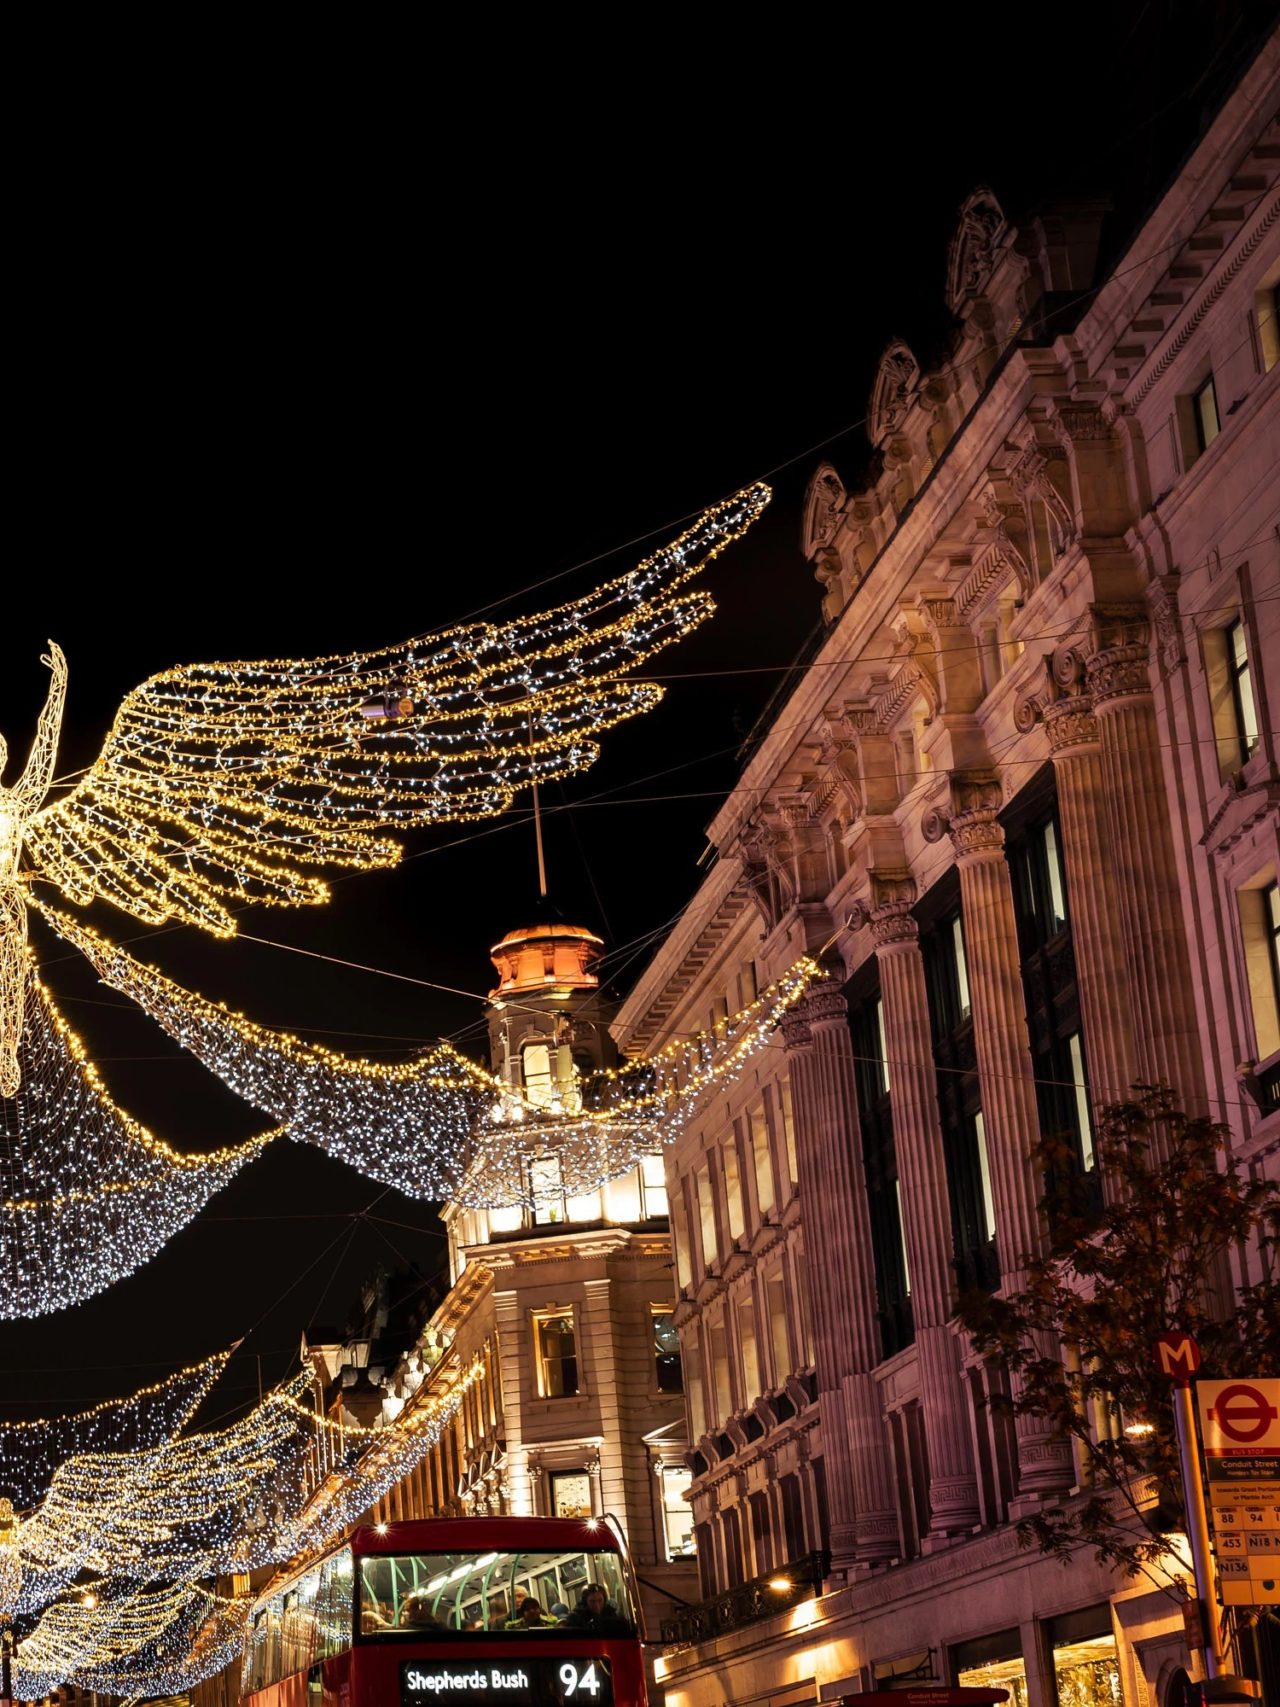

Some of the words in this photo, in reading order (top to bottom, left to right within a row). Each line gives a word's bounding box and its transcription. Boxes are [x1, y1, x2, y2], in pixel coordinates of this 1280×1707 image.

[1158, 1339, 1196, 1374] M
[1221, 1460, 1252, 1468] Conduit
[1254, 1460, 1279, 1468] Street
[1221, 1514, 1235, 1523] 88
[1250, 1513, 1263, 1522] 94
[1223, 1539, 1241, 1548] 453
[1249, 1537, 1270, 1547] N18
[1220, 1562, 1248, 1572] N136
[407, 1670, 488, 1695] Shepherds
[491, 1669, 529, 1689] Bush
[559, 1663, 601, 1697] 94
